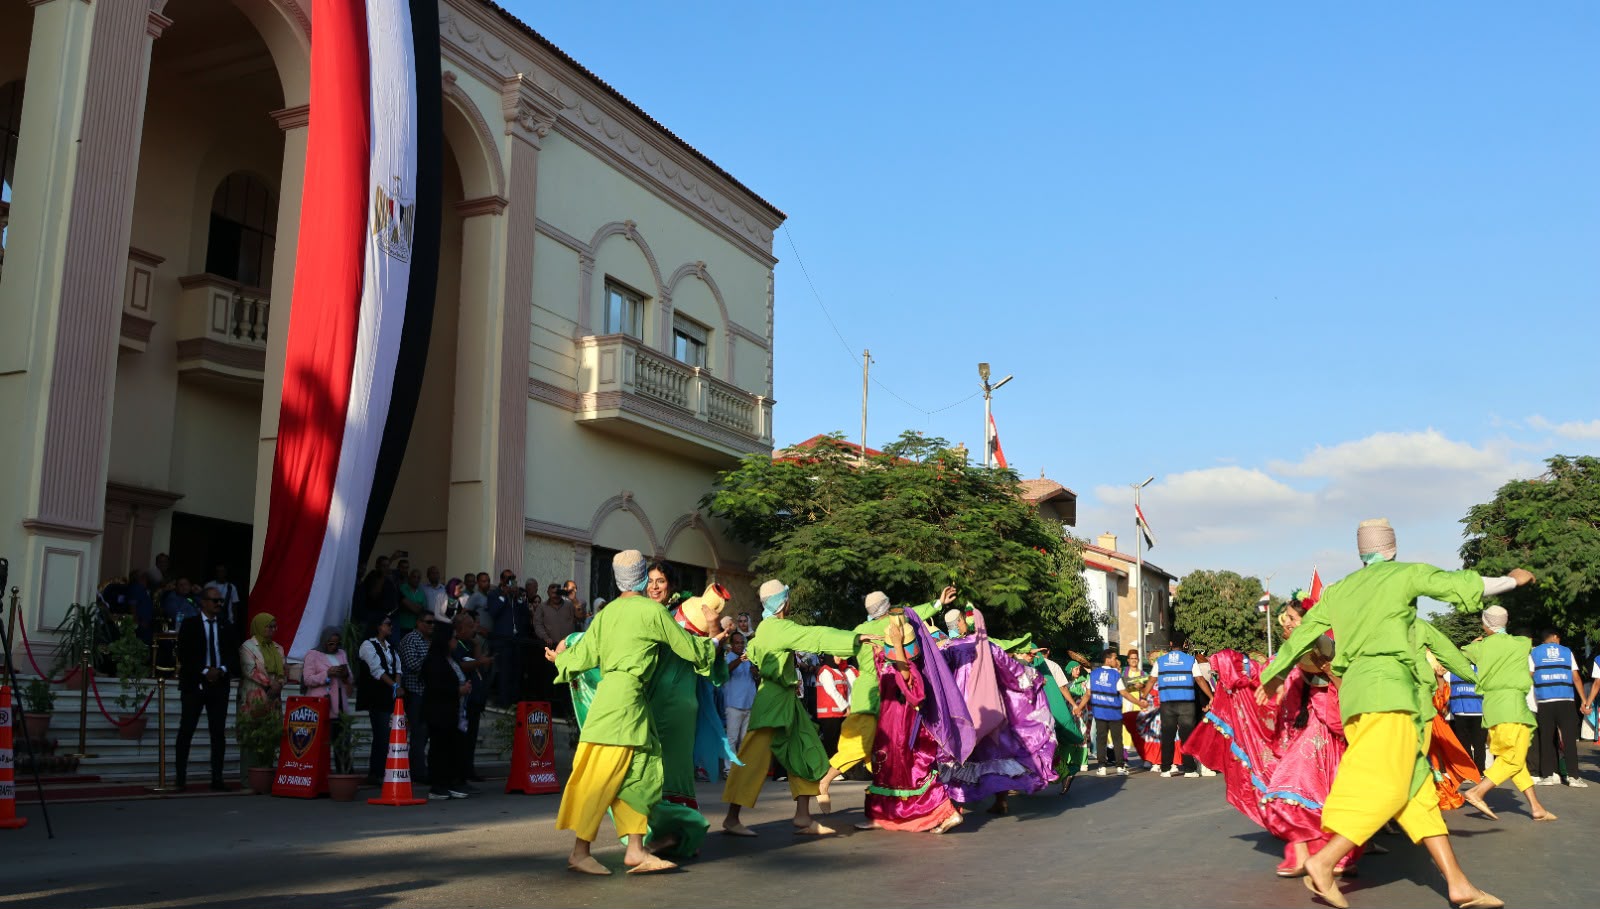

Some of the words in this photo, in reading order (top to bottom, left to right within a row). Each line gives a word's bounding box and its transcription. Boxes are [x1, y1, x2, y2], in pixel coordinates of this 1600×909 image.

[291, 708, 318, 722] TRAFFIC
[528, 712, 548, 723] TRAFFIC
[278, 775, 286, 784] NO
[287, 775, 312, 786] PARKING
[537, 774, 555, 782] PARKING
